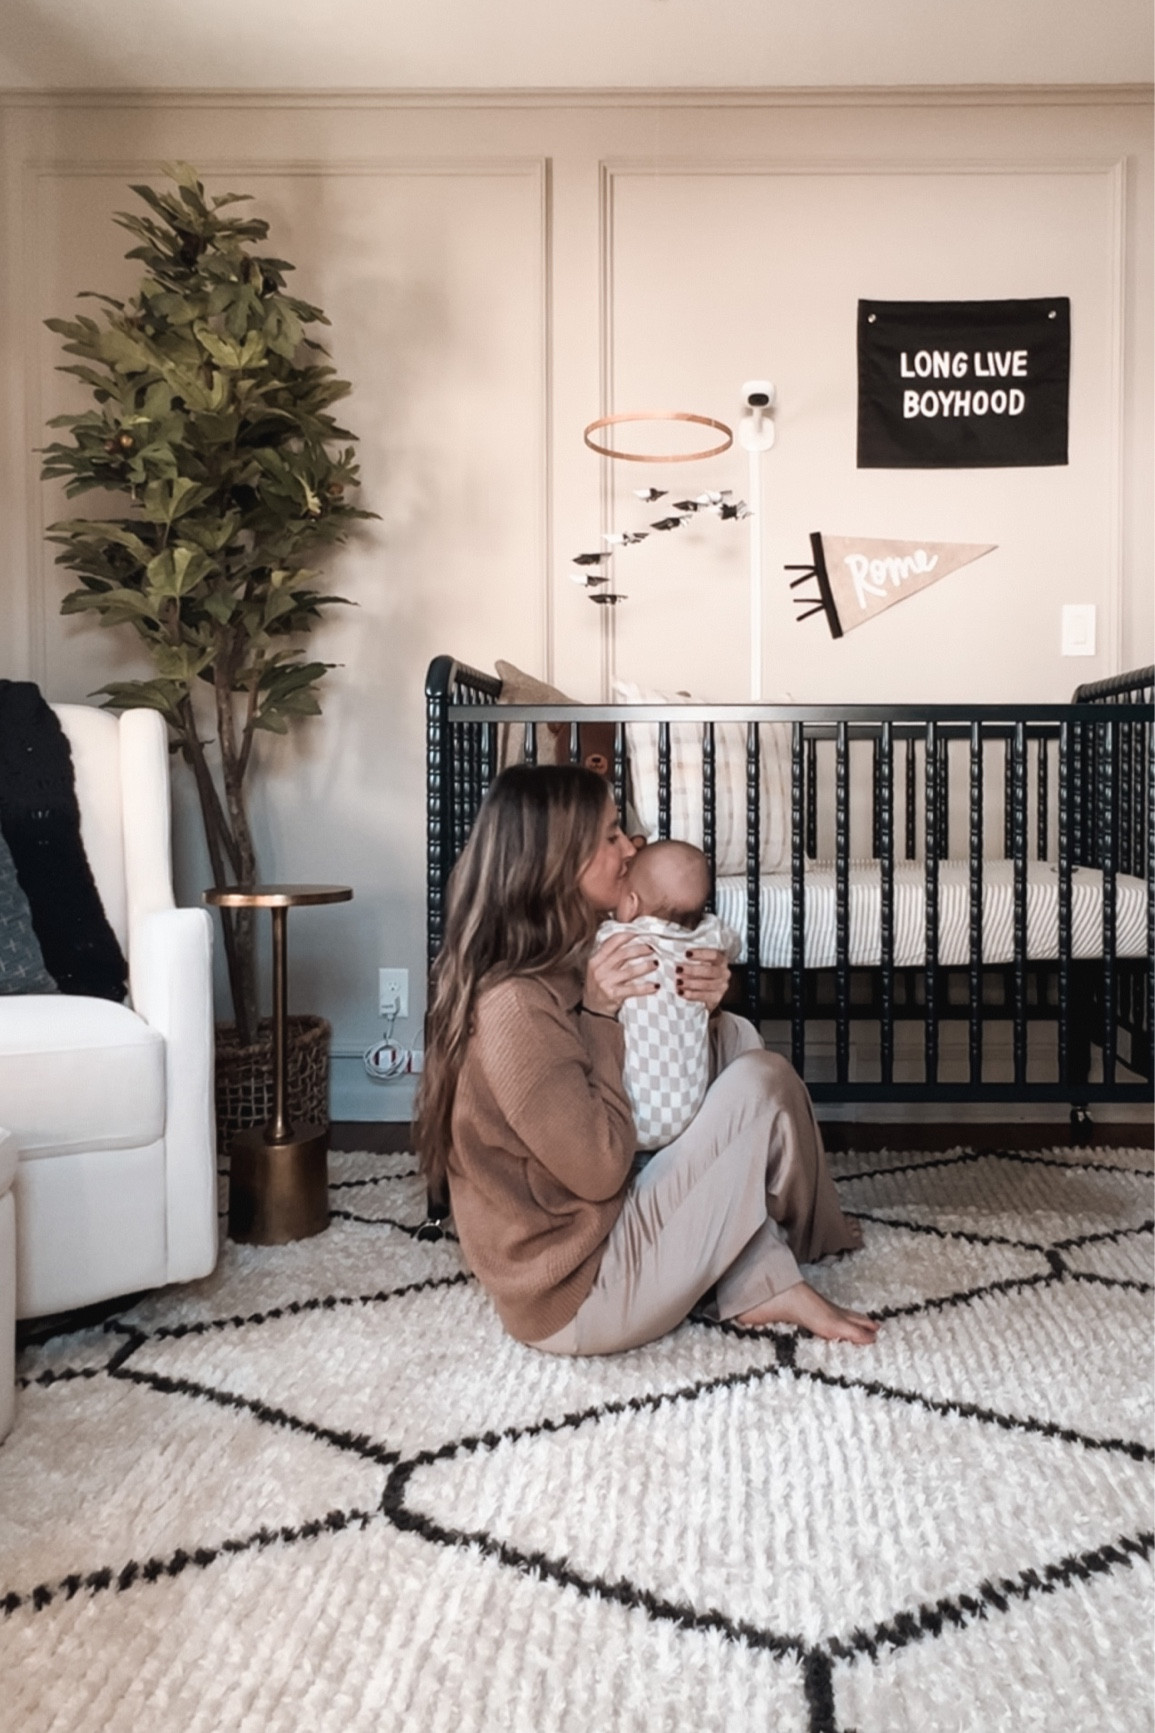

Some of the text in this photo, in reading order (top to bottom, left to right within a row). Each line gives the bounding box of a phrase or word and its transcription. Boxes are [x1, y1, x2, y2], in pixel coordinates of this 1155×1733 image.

[900, 350, 1028, 378] LONG LIVE
[903, 389, 1025, 418] BOYHOOD
[844, 548, 938, 609] Rome
